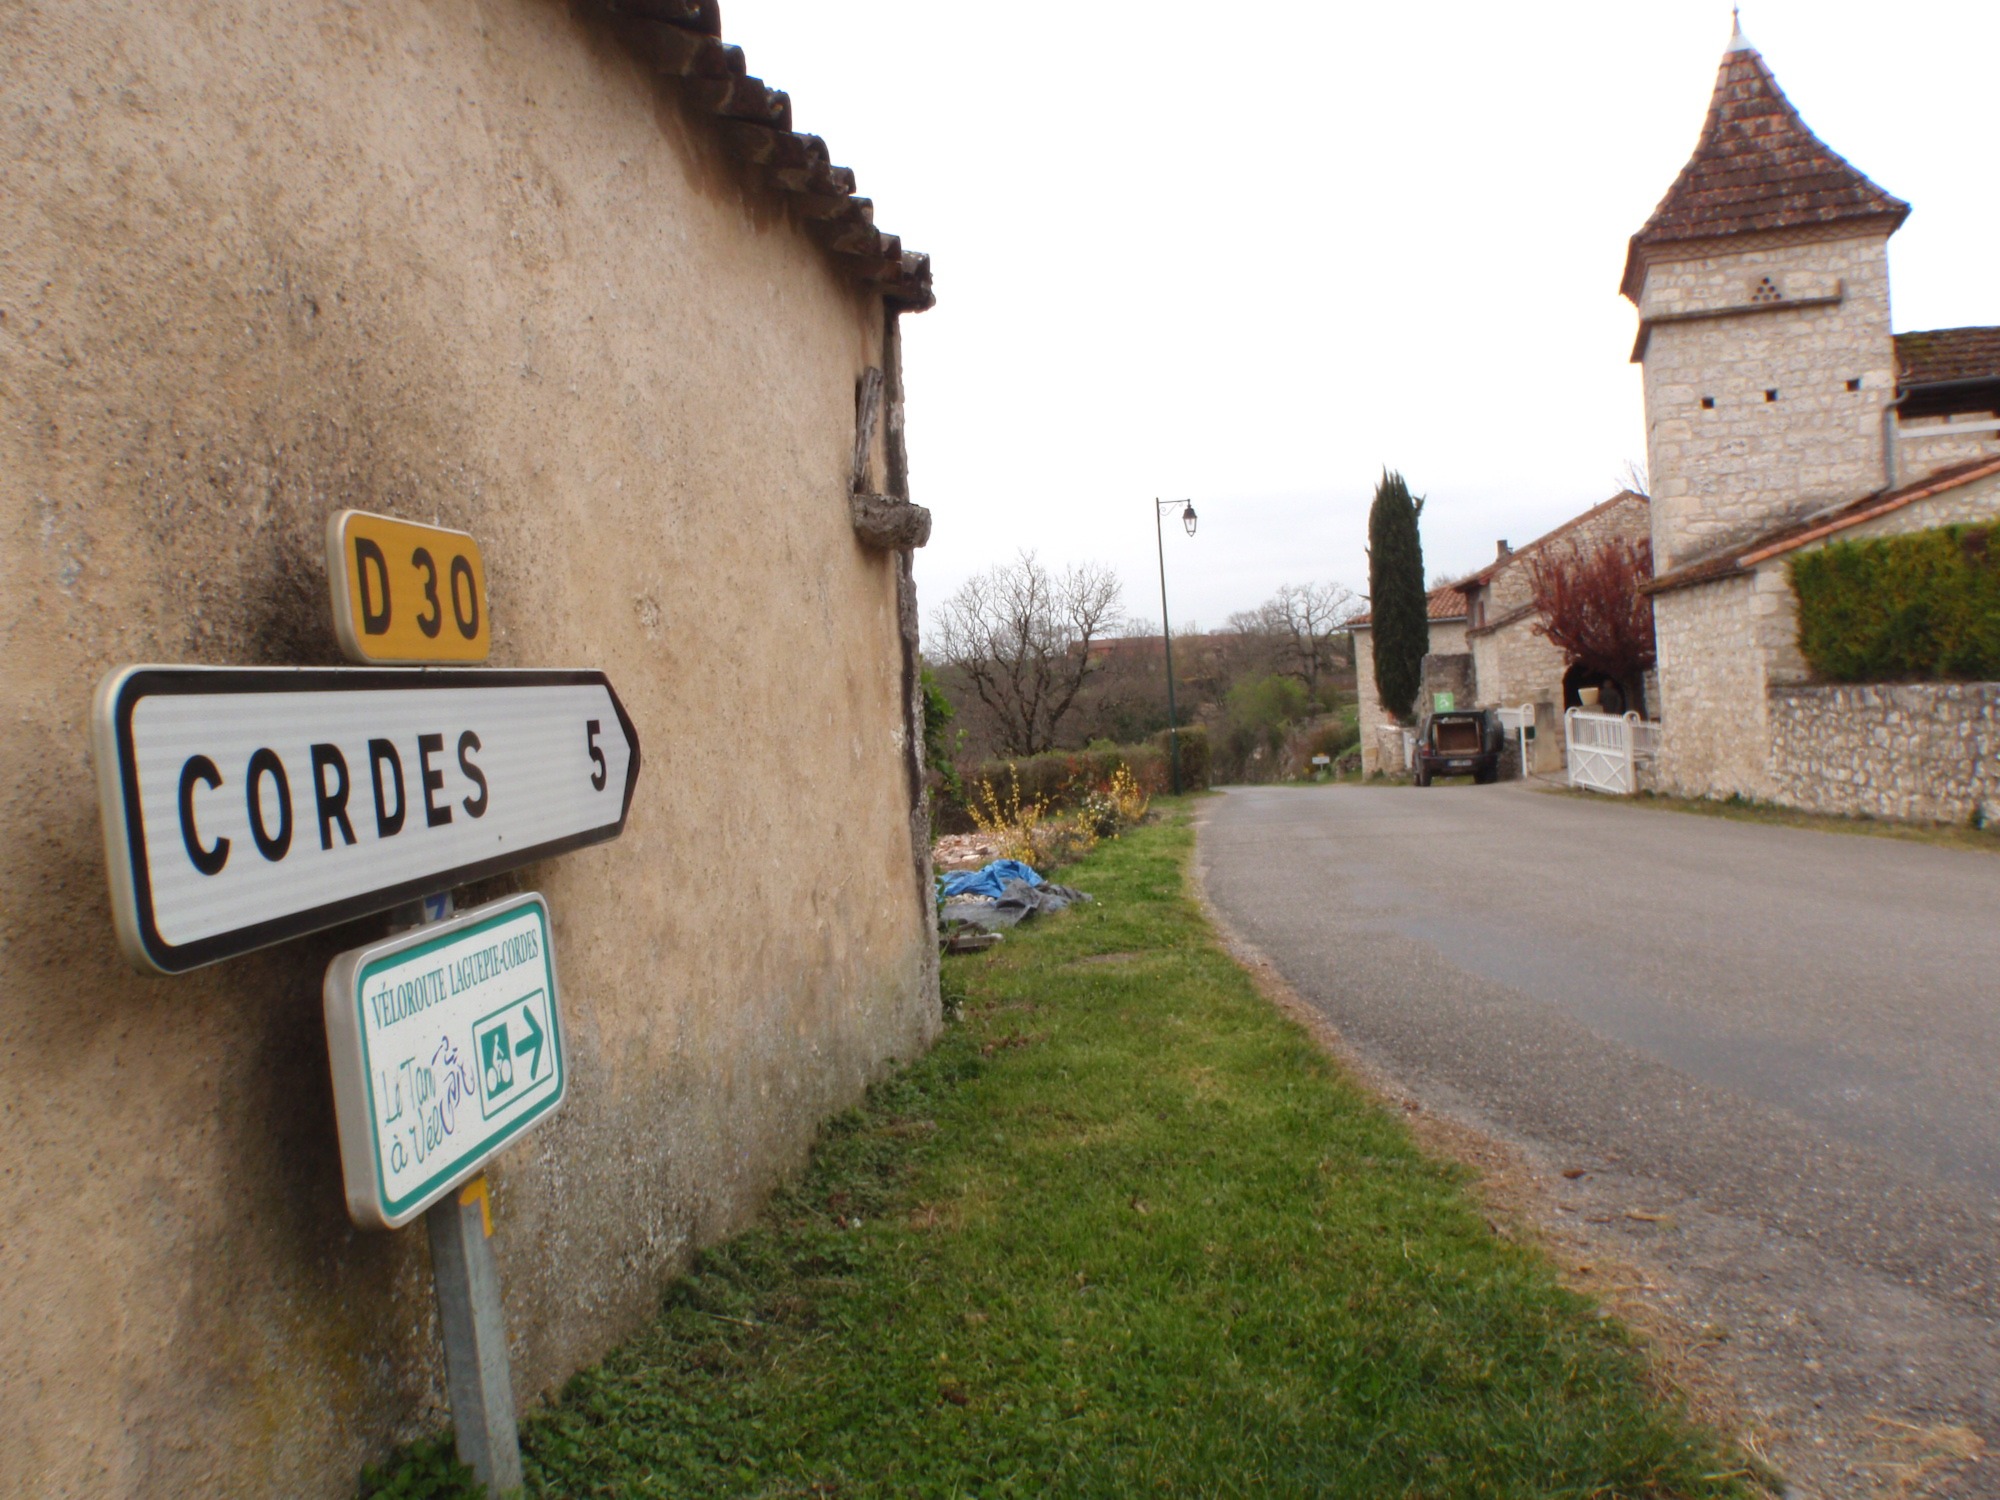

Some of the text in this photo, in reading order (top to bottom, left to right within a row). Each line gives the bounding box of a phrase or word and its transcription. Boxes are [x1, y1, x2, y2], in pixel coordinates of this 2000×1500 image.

[355, 536, 481, 641] D 30
[177, 719, 607, 876] CORDES 5
[371, 928, 540, 1031] VÉLOROUTE LAGUEPIE-CORDES
[381, 1070, 404, 1124] Le
[390, 1133, 409, 1174] à
